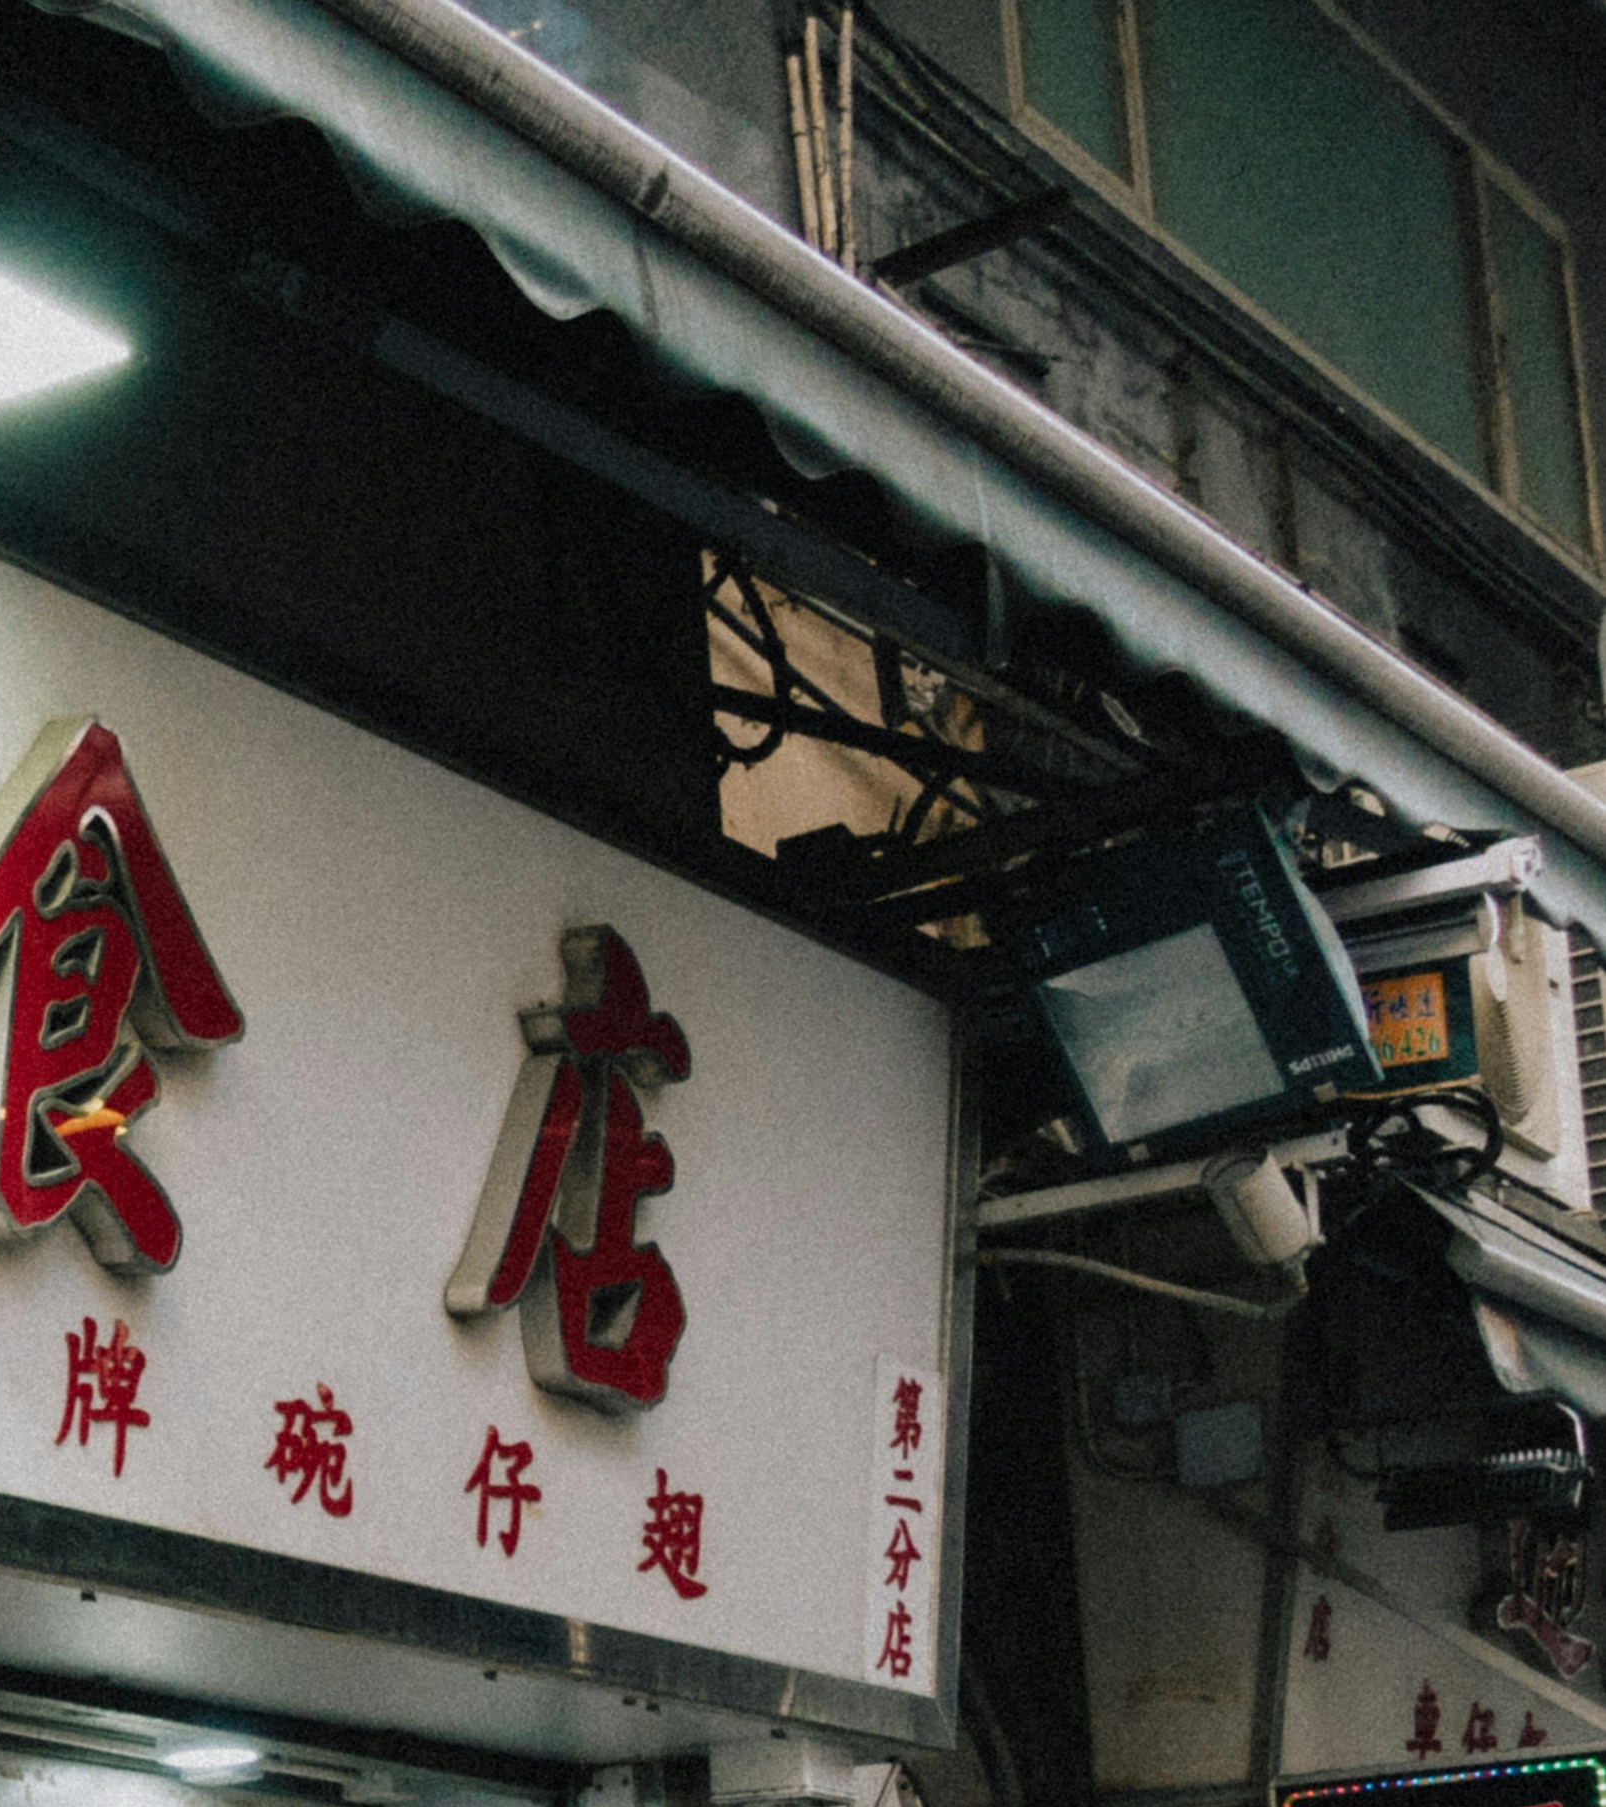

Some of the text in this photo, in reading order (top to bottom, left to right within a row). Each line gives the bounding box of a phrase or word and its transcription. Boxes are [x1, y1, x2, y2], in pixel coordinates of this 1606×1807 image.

[1289, 1043, 1355, 1076] PHILIPS
[875, 1374, 927, 1681] 第二分店
